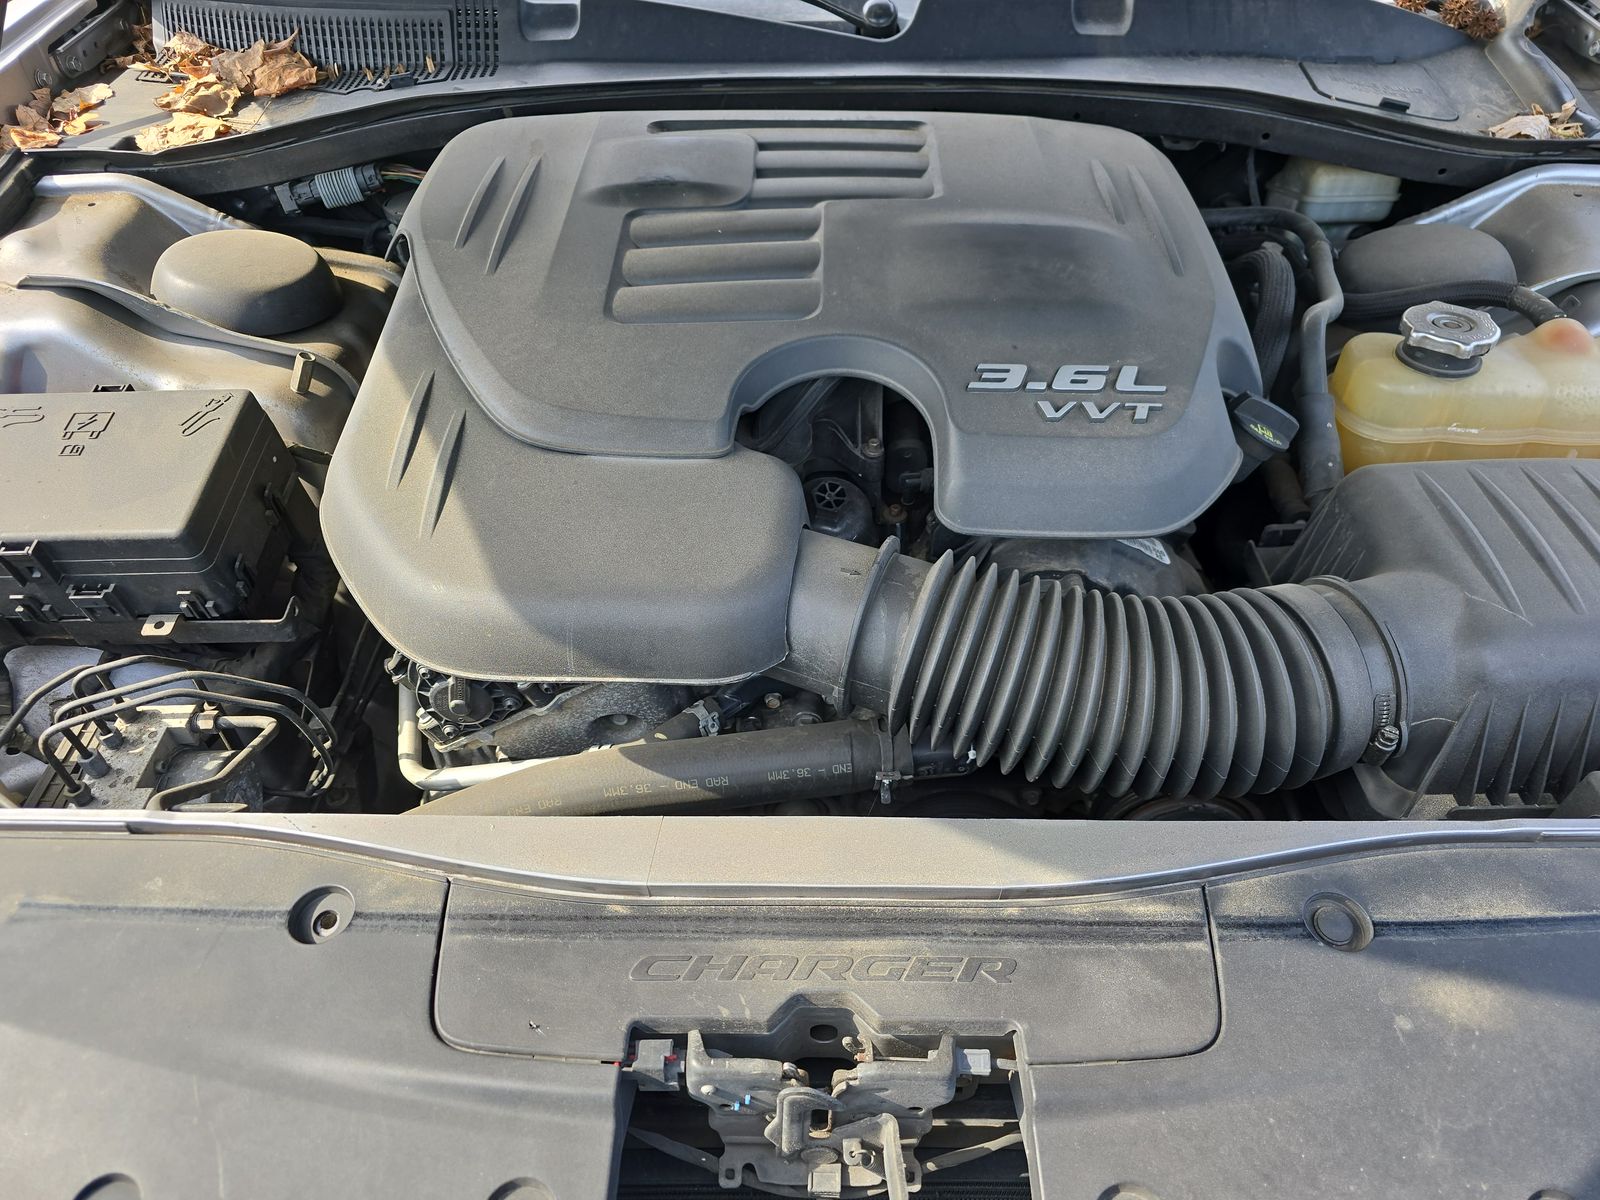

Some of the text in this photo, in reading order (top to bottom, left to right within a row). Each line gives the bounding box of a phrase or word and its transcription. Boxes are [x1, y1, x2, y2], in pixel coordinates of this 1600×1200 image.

[966, 363, 1168, 395] 3.6L
[1036, 400, 1164, 424] VVT
[767, 766, 812, 782] 36.3MM
[832, 763, 853, 774] END
[674, 779, 699, 791] END
[705, 776, 730, 788] RAD
[603, 783, 653, 798] 36.3MM
[628, 954, 1018, 984] CHARGER
